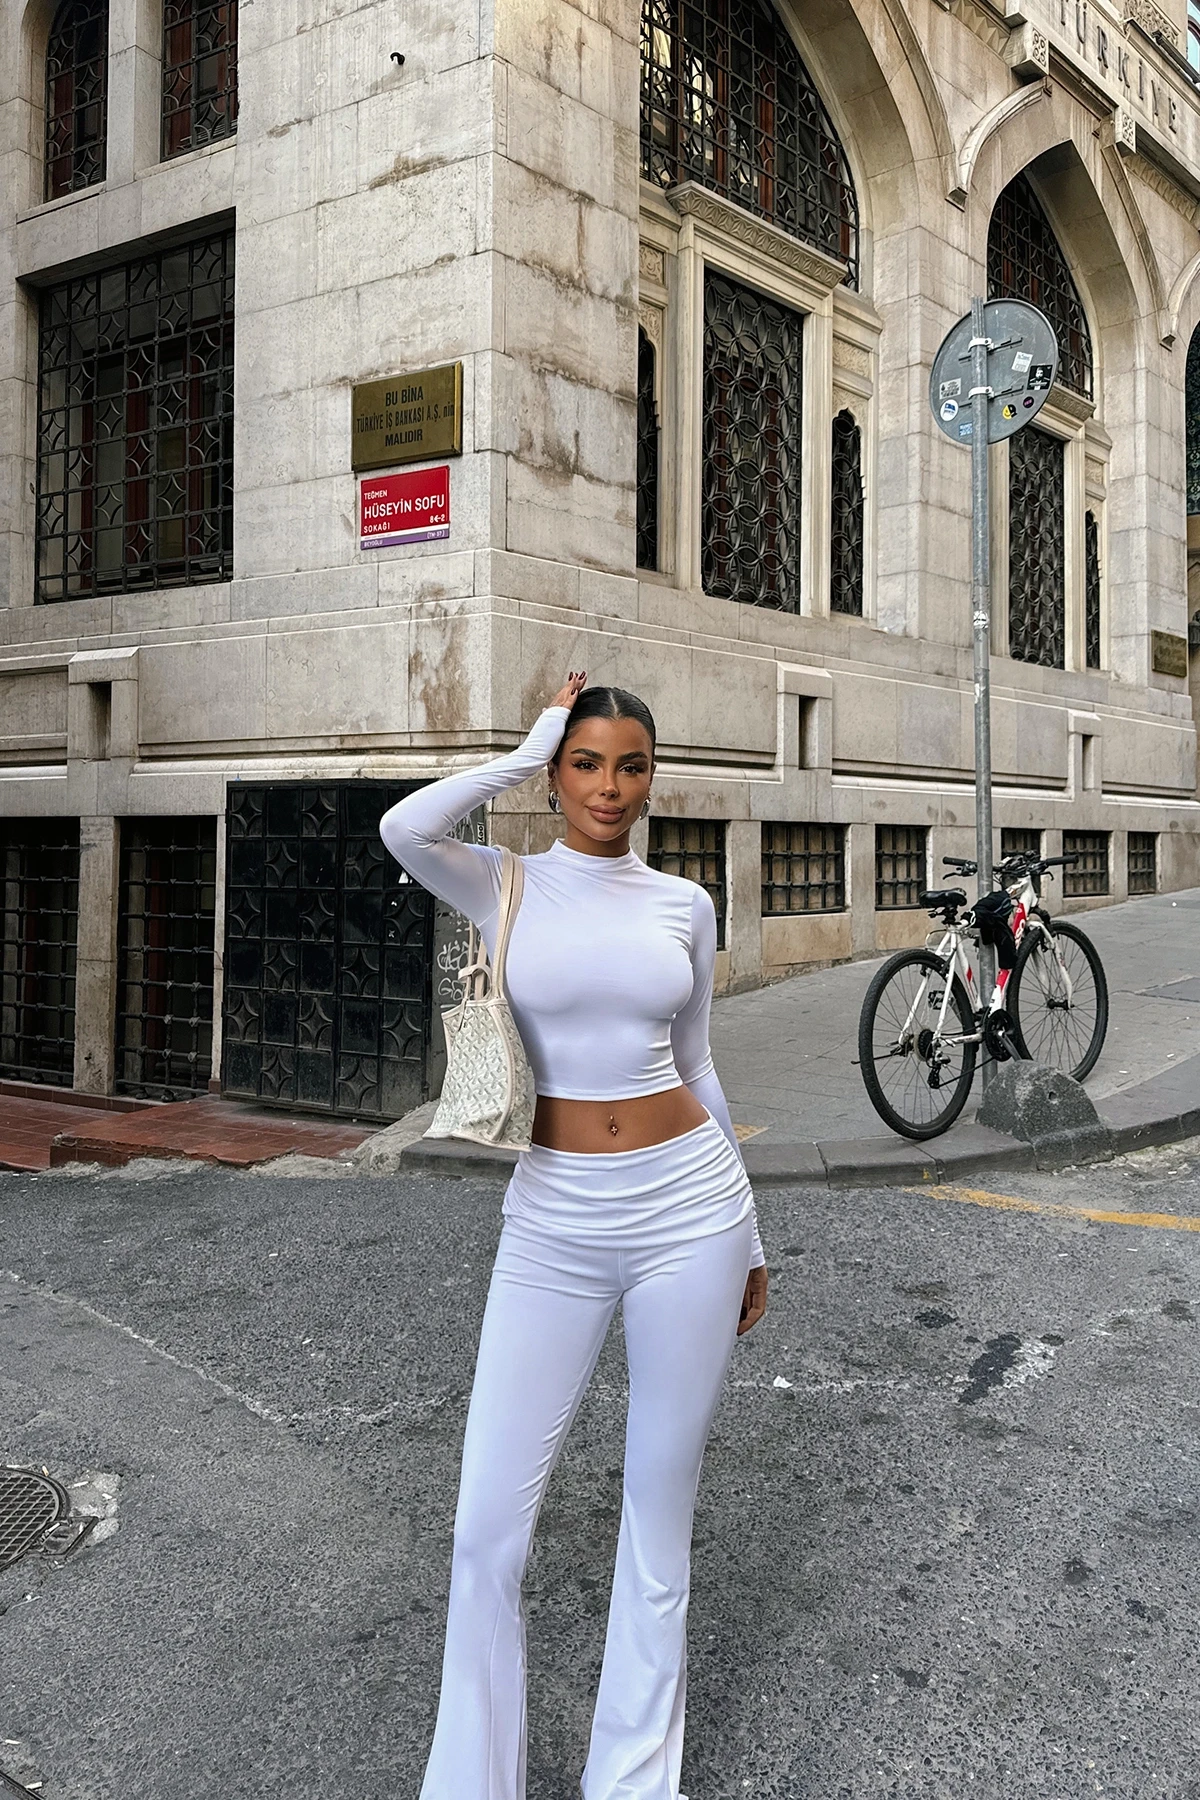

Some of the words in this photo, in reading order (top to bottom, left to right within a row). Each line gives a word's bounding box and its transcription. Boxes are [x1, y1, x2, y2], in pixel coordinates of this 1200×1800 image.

[385, 391, 398, 407] BU
[401, 385, 424, 404] BİNA
[357, 412, 383, 433] TÜRKİYE
[385, 410, 393, 431] İŞ
[395, 406, 424, 427] BANKASI
[385, 428, 423, 447] MALIDIR
[364, 489, 388, 500] TEĞMEN
[364, 498, 412, 520] HÜSEYİN
[415, 494, 445, 512] SOFU
[363, 521, 390, 534] SOKAĞI
